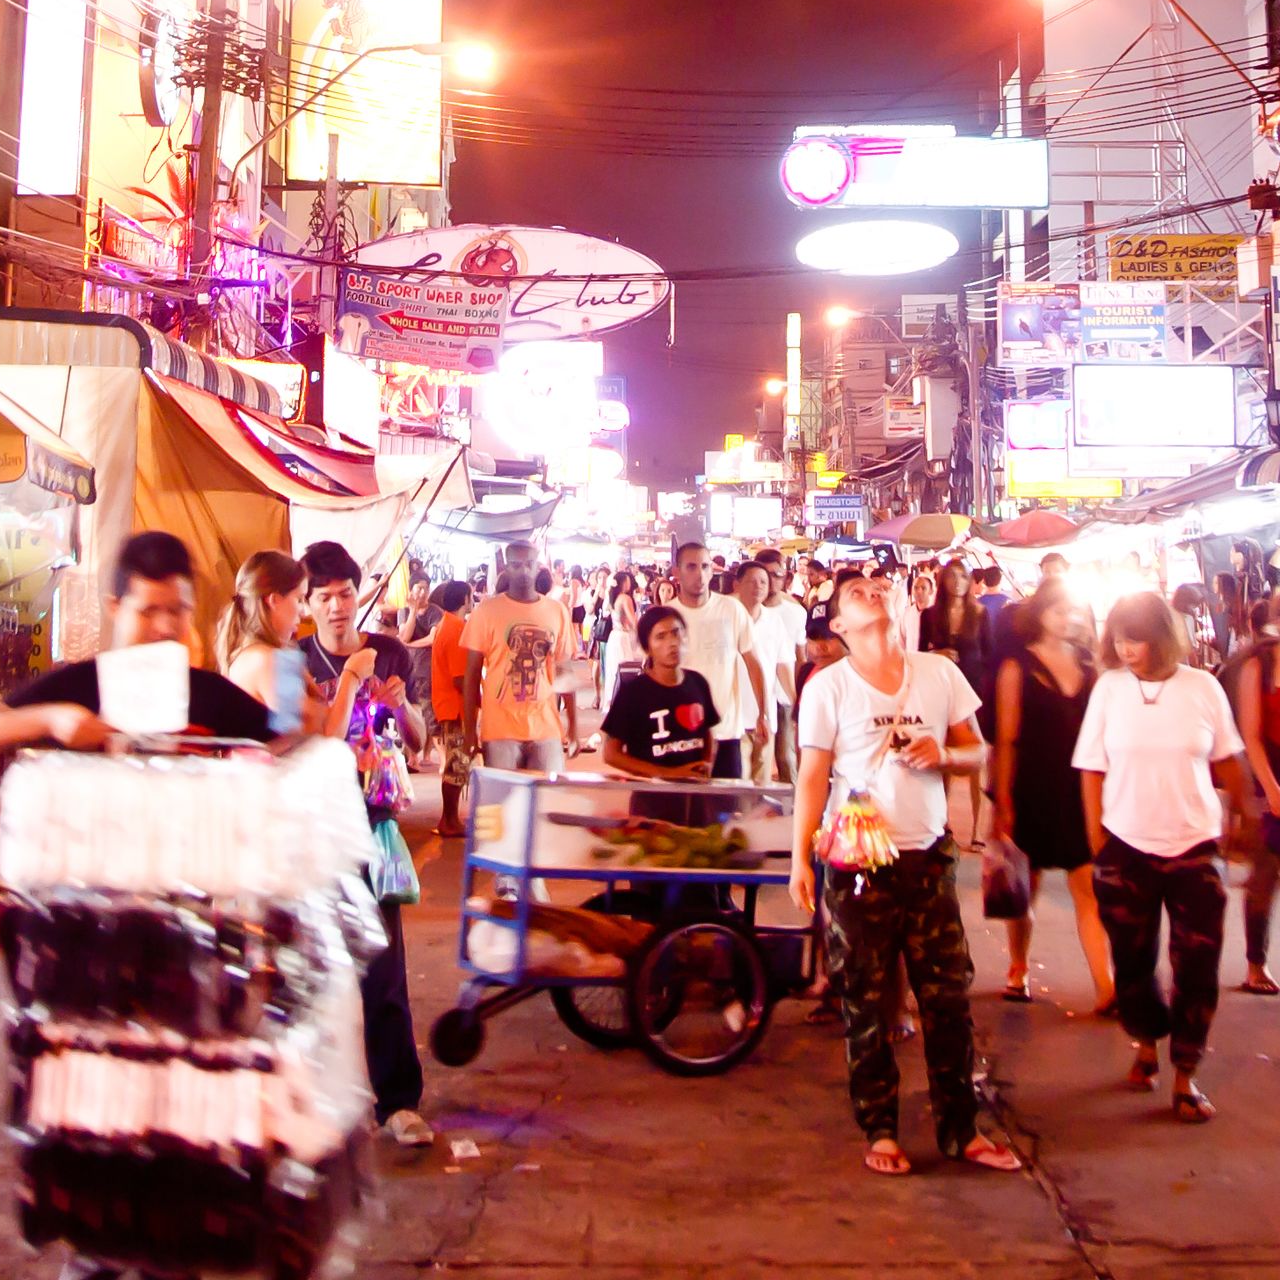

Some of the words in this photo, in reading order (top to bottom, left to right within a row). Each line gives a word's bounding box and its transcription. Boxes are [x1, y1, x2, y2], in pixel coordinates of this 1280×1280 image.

[1115, 239, 1168, 258] D&D
[1120, 261, 1168, 273] LADIES
[1174, 261, 1183, 273] &
[377, 279, 421, 301] SPORT
[426, 287, 464, 306] WAER
[469, 292, 503, 306] SHOP
[510, 268, 650, 317] Club
[345, 290, 392, 308] FOOTBALL
[399, 302, 429, 314] SHIRT
[436, 307, 458, 317] THAI
[1093, 306, 1153, 316] TOURIST
[389, 316, 420, 329] WHOLE
[422, 320, 444, 332] SALE
[447, 324, 466, 335] AND
[1083, 316, 1165, 326] INFORMATION
[816, 498, 862, 507] DRUGSTORE
[649, 709, 670, 740] I
[873, 715, 924, 727] SINHA
